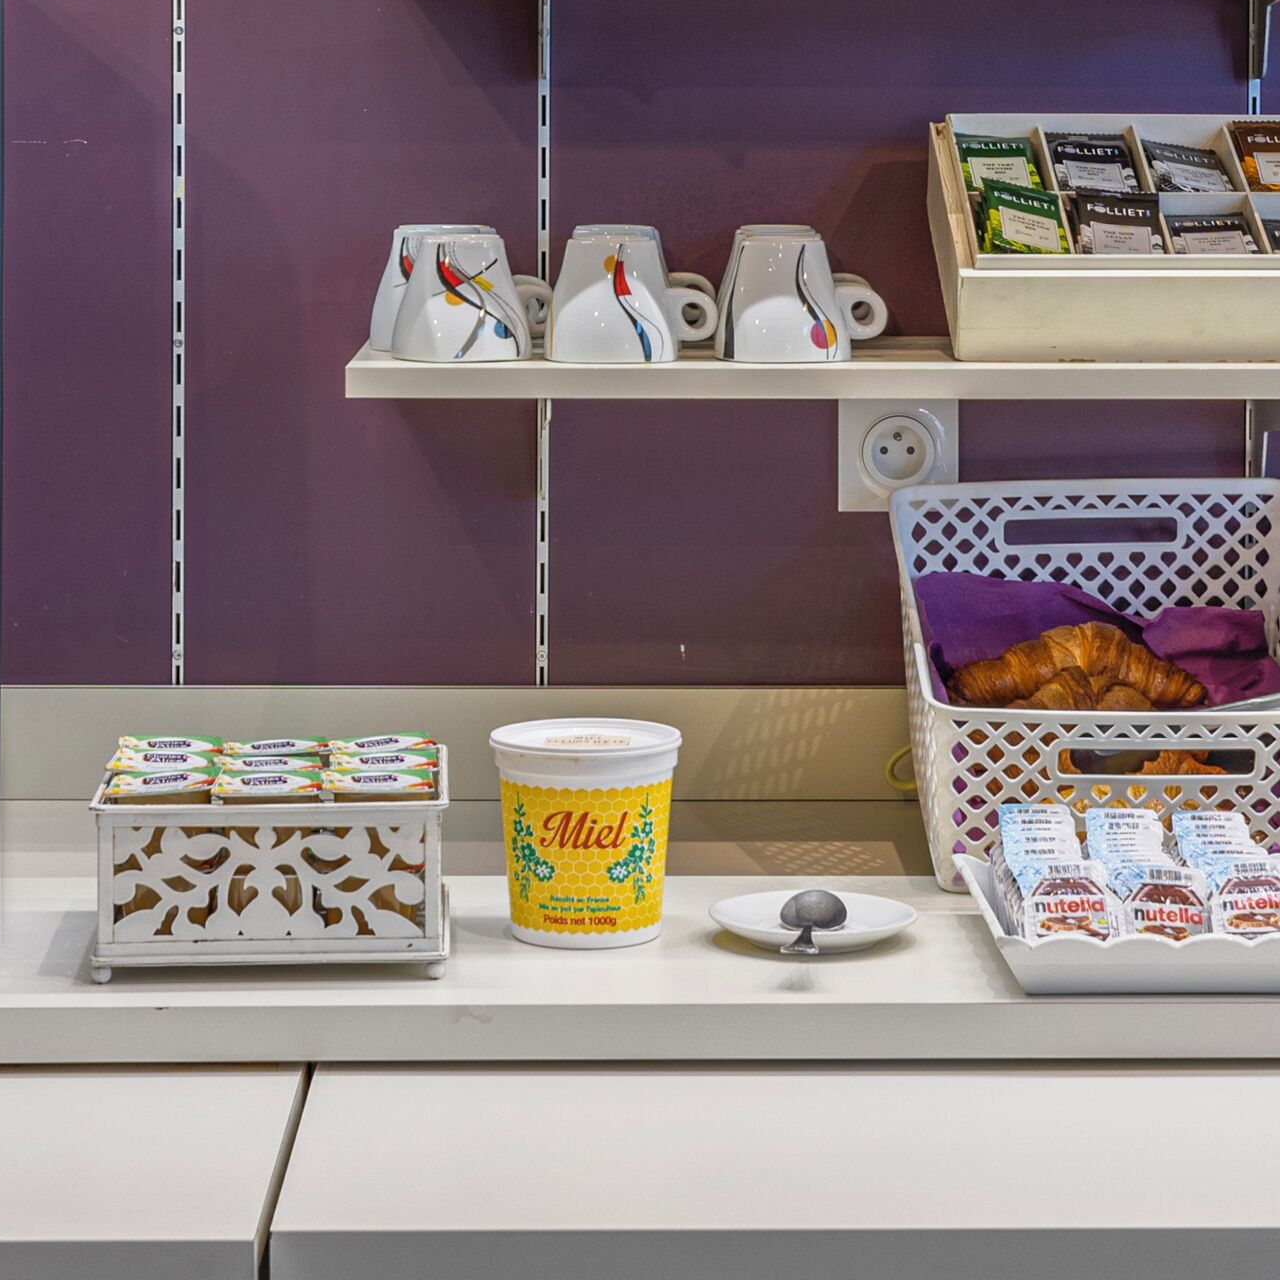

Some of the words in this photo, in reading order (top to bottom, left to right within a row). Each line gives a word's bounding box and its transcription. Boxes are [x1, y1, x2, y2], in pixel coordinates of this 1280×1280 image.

[1057, 145, 1114, 156] FOLLIET
[1086, 202, 1145, 217] FOLLIET
[539, 810, 629, 850] Miel
[1034, 896, 1105, 915] nutella
[543, 914, 568, 925] Poids
[570, 916, 586, 926] net
[589, 916, 617, 927] 1000g
[1134, 906, 1204, 925] nutella
